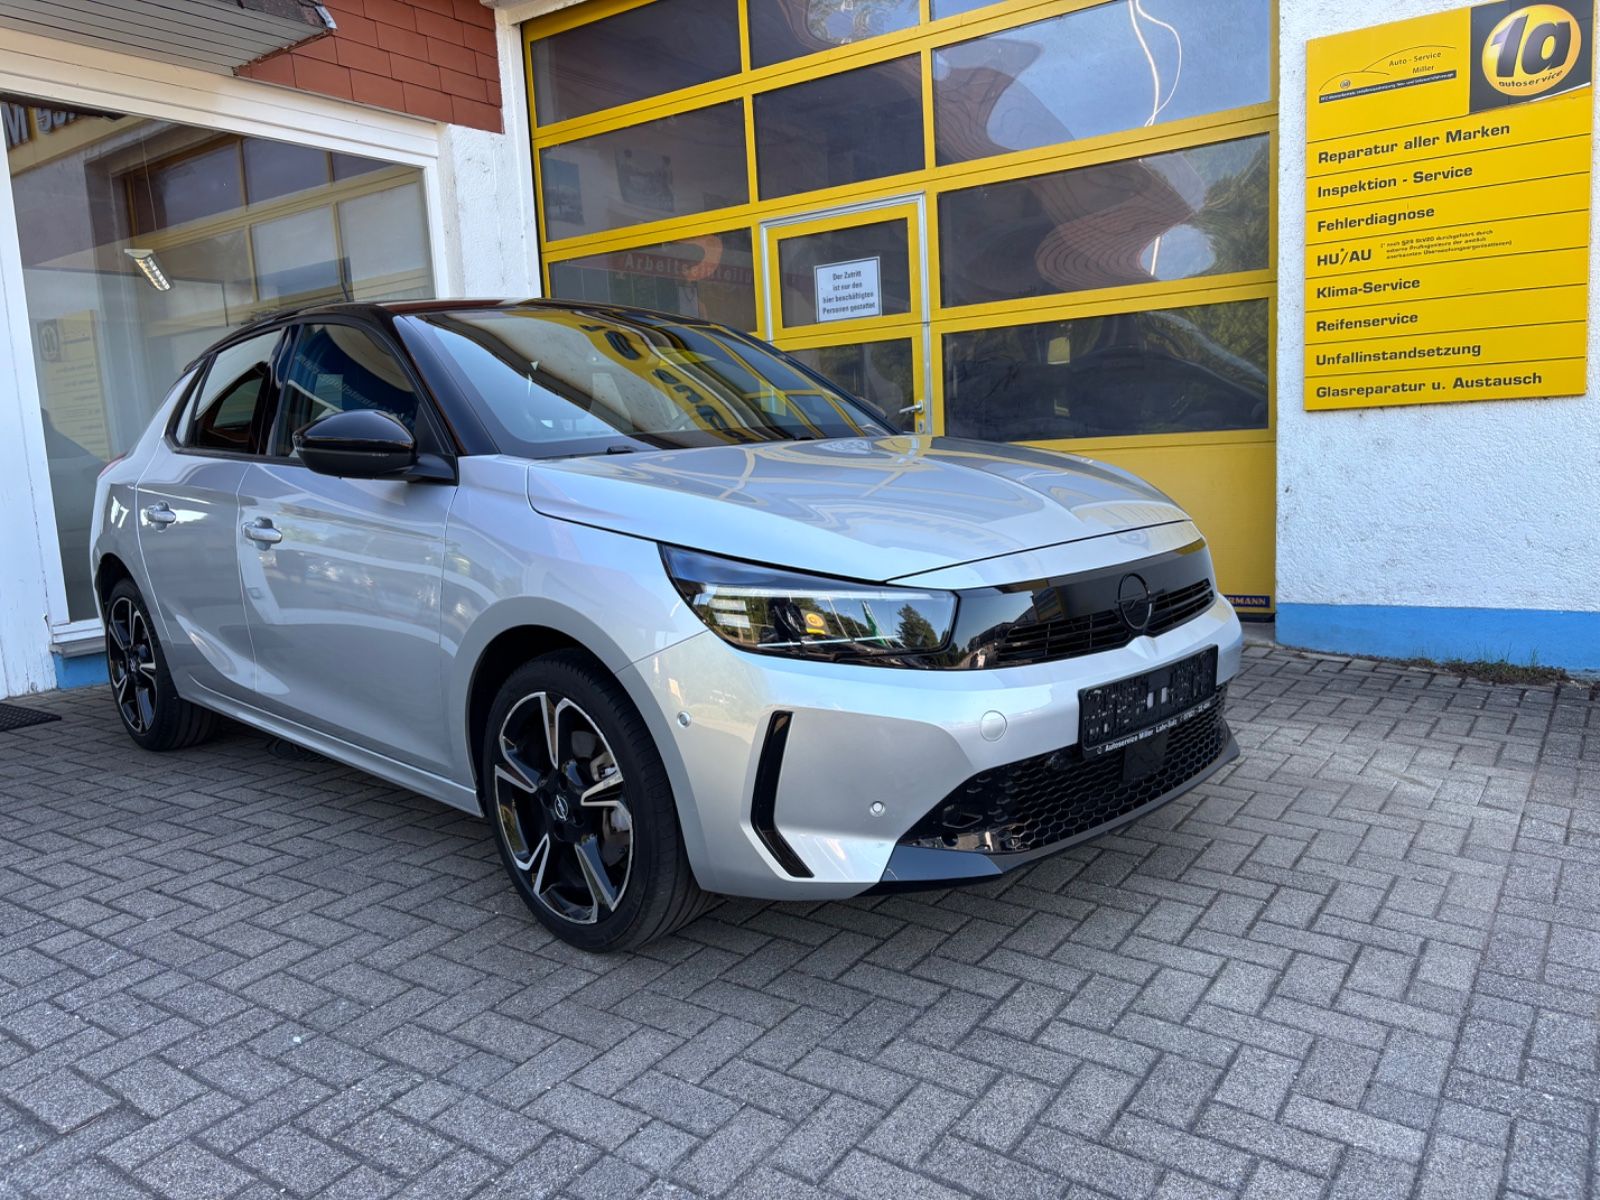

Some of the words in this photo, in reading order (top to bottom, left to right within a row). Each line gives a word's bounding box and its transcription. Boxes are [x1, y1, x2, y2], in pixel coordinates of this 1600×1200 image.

[1491, 14, 1571, 77] 1a
[1388, 58, 1407, 68] Auto
[1414, 52, 1442, 62] Service
[1412, 65, 1434, 74] Miller
[1498, 69, 1563, 87] autoservice
[1318, 141, 1398, 163] Reparatur
[1403, 136, 1440, 151] aller
[1445, 124, 1510, 144] Marken
[1317, 177, 1397, 198] Inspektion
[1412, 165, 1473, 184] Service
[1317, 206, 1435, 233] Fehlerdiagnose
[832, 272, 843, 281] Der
[844, 270, 862, 279] Zutritt
[832, 284, 840, 292] ist
[852, 281, 863, 289] den
[1316, 278, 1421, 299] Klima-Service
[822, 296, 834, 304] hier
[822, 305, 849, 314] Personen
[850, 302, 876, 312] gestattet
[1316, 312, 1418, 332] Reifenservice
[1316, 342, 1482, 366] Unfallinstandsetzung
[1316, 378, 1426, 399] Glasreparatur
[1431, 380, 1446, 390] u.
[1452, 372, 1543, 389] Austausch
[1228, 596, 1266, 606] RMANN
